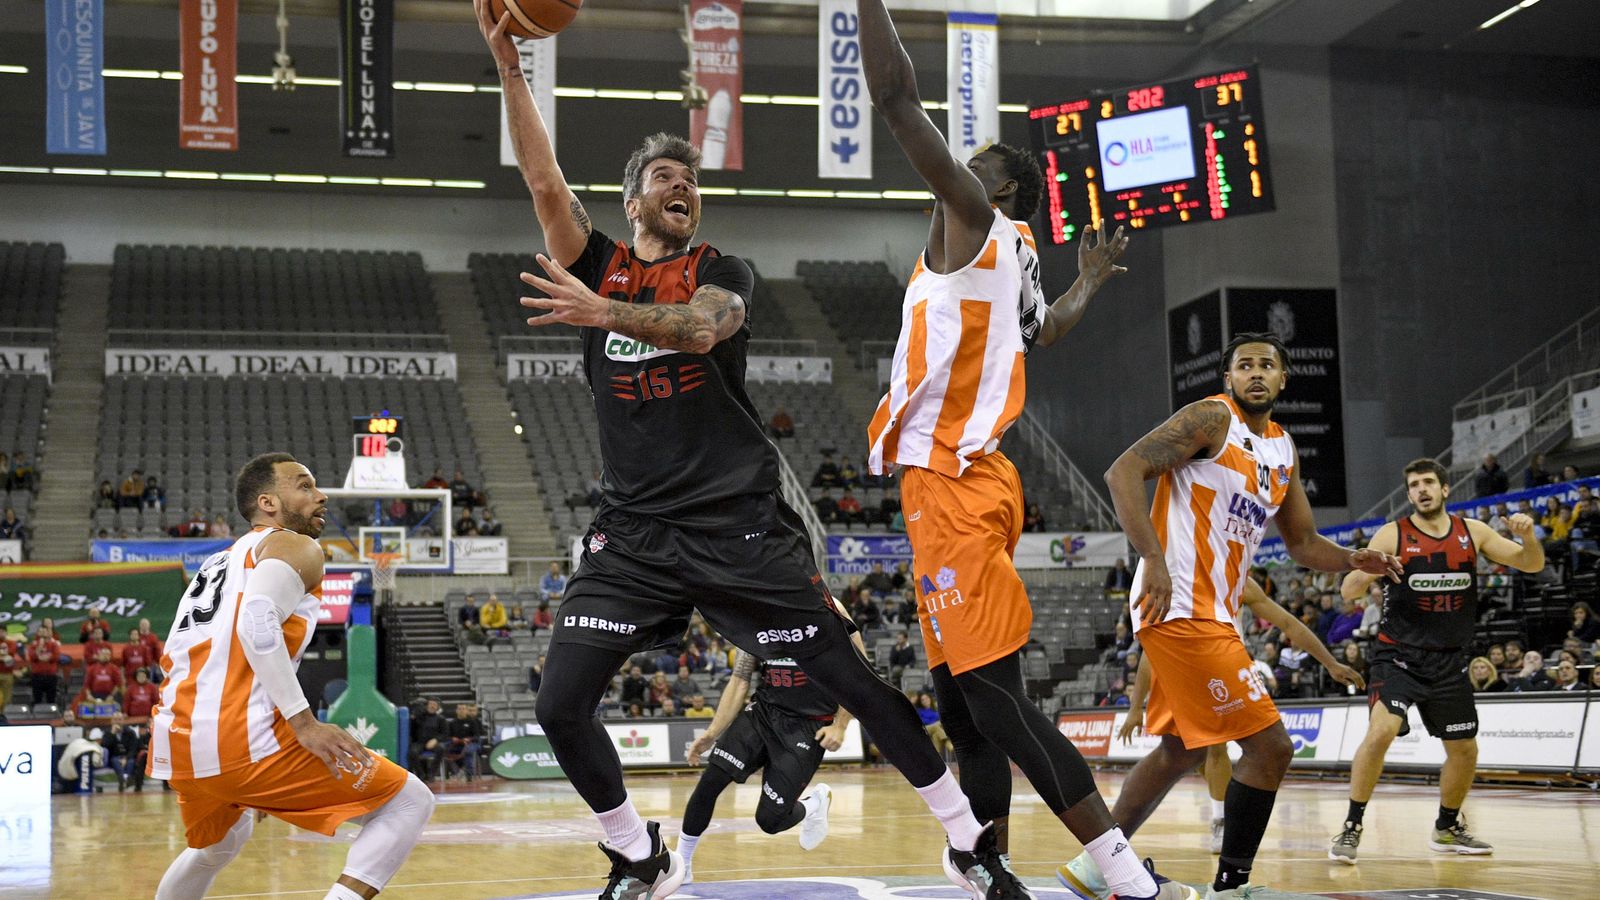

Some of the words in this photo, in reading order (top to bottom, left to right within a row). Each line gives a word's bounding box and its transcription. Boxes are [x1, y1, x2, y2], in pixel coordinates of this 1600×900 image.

[200, 57, 218, 122] LUNA
[361, 70, 375, 129] LUNA
[958, 32, 977, 148] aeroprint
[1127, 85, 1165, 111] 202
[1216, 82, 1243, 106] 37
[1056, 112, 1082, 135] 27
[1130, 136, 1153, 155] HLA
[114, 354, 218, 374] IDEAL
[232, 355, 332, 375] IDEAL
[344, 355, 446, 377] IDEAL
[638, 366, 673, 401] 15
[1257, 463, 1271, 491] 30
[1433, 594, 1453, 613] 21
[579, 616, 637, 636] BERNER
[771, 669, 792, 688] 55
[1087, 720, 1112, 737] LUNA
[80, 754, 90, 790] PULEVA
